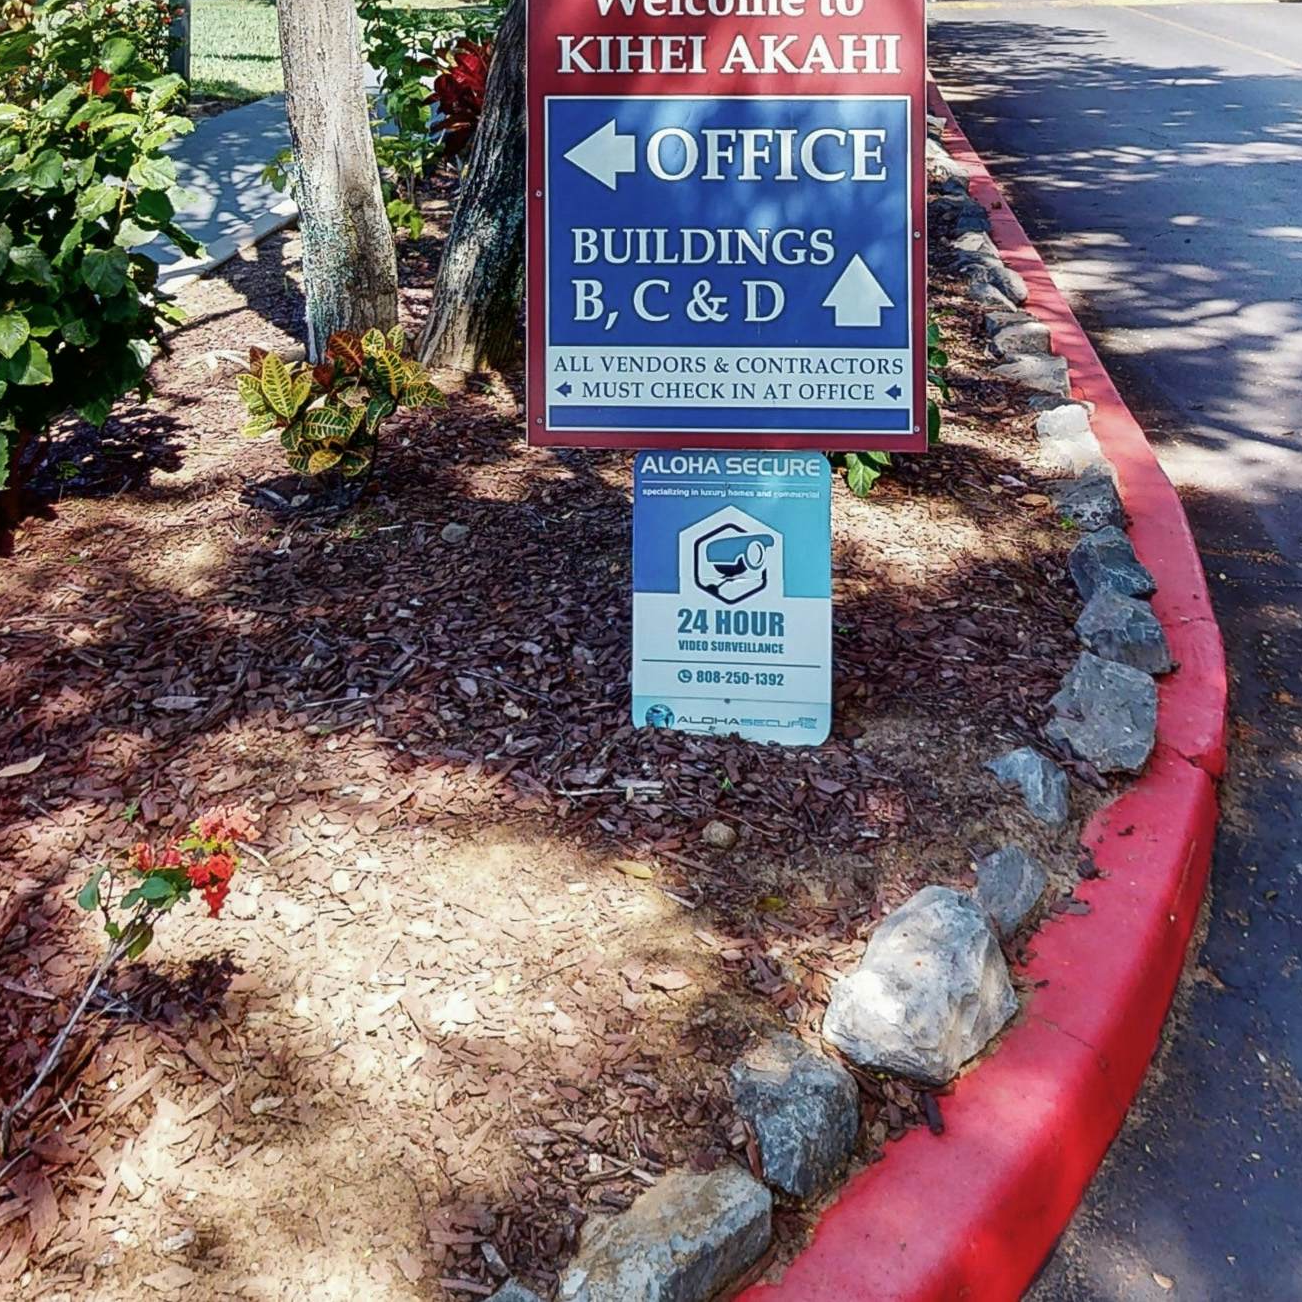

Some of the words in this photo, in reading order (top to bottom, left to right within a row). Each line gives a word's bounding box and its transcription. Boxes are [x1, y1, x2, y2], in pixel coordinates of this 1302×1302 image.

[556, 35, 707, 74] KIHEI
[720, 34, 901, 74] AKAHI
[646, 127, 888, 182] OFFICE
[571, 228, 835, 265] BUILDINGS
[571, 279, 619, 330] B,
[633, 279, 670, 322] C
[686, 280, 729, 322] &
[742, 280, 786, 322] D
[553, 356, 594, 373] ALL
[600, 356, 707, 373] VENDORS
[714, 357, 730, 374] &
[735, 356, 904, 375] CONTRACTORS
[581, 381, 645, 398] MUST
[650, 382, 726, 399] CHECK
[732, 383, 757, 400] IN
[763, 383, 793, 400] AT
[798, 383, 876, 400] OFFICE
[640, 456, 722, 475] ALOHA
[725, 457, 821, 477] SECURE
[642, 488, 690, 498] specializing
[691, 488, 699, 496] in
[701, 489, 726, 498] luxury
[728, 489, 755, 498] homes
[756, 489, 772, 498] and
[773, 490, 821, 499] commercial
[677, 608, 709, 635] 24
[715, 609, 785, 637] HOUR
[678, 639, 709, 652] VIDEO
[710, 640, 785, 655] SURVEILLANCE
[696, 669, 785, 687] 808-250-1392
